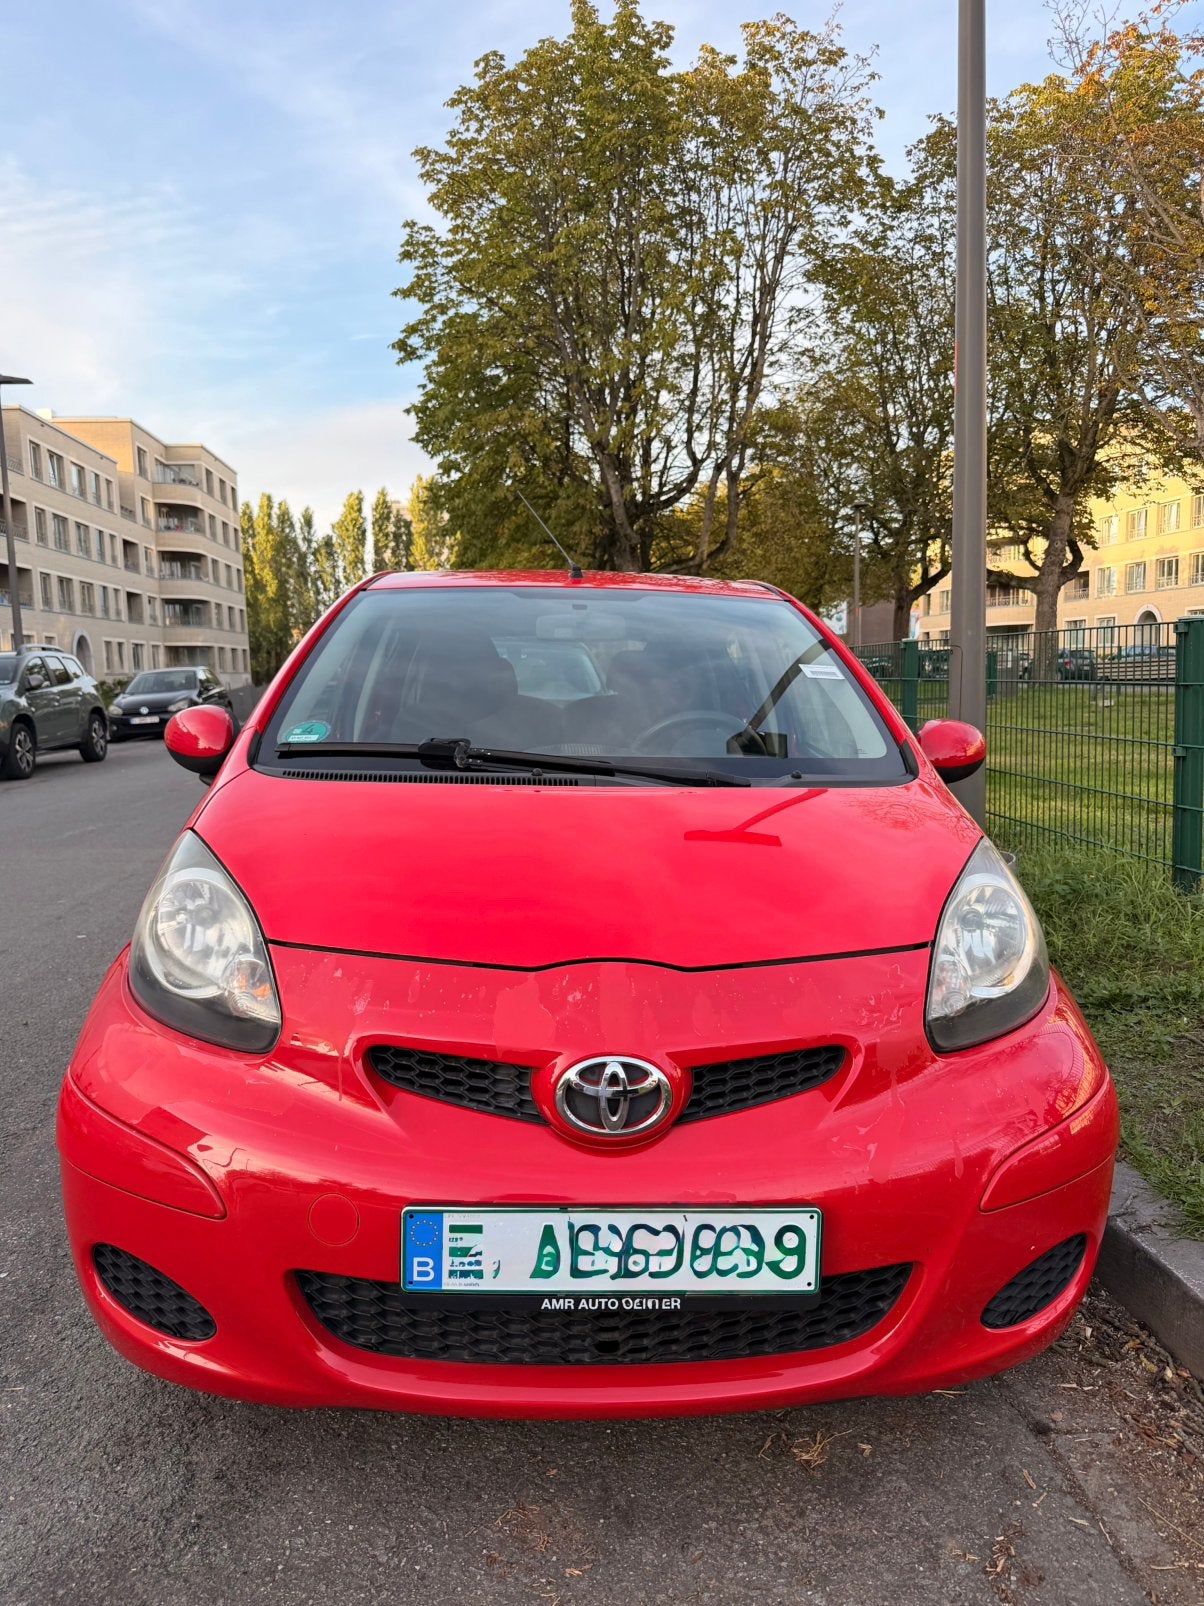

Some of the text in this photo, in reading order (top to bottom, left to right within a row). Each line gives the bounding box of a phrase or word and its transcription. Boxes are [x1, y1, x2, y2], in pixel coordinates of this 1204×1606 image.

[413, 1257, 435, 1281] B
[541, 1298, 575, 1310] AMR
[578, 1298, 619, 1310] AUTO
